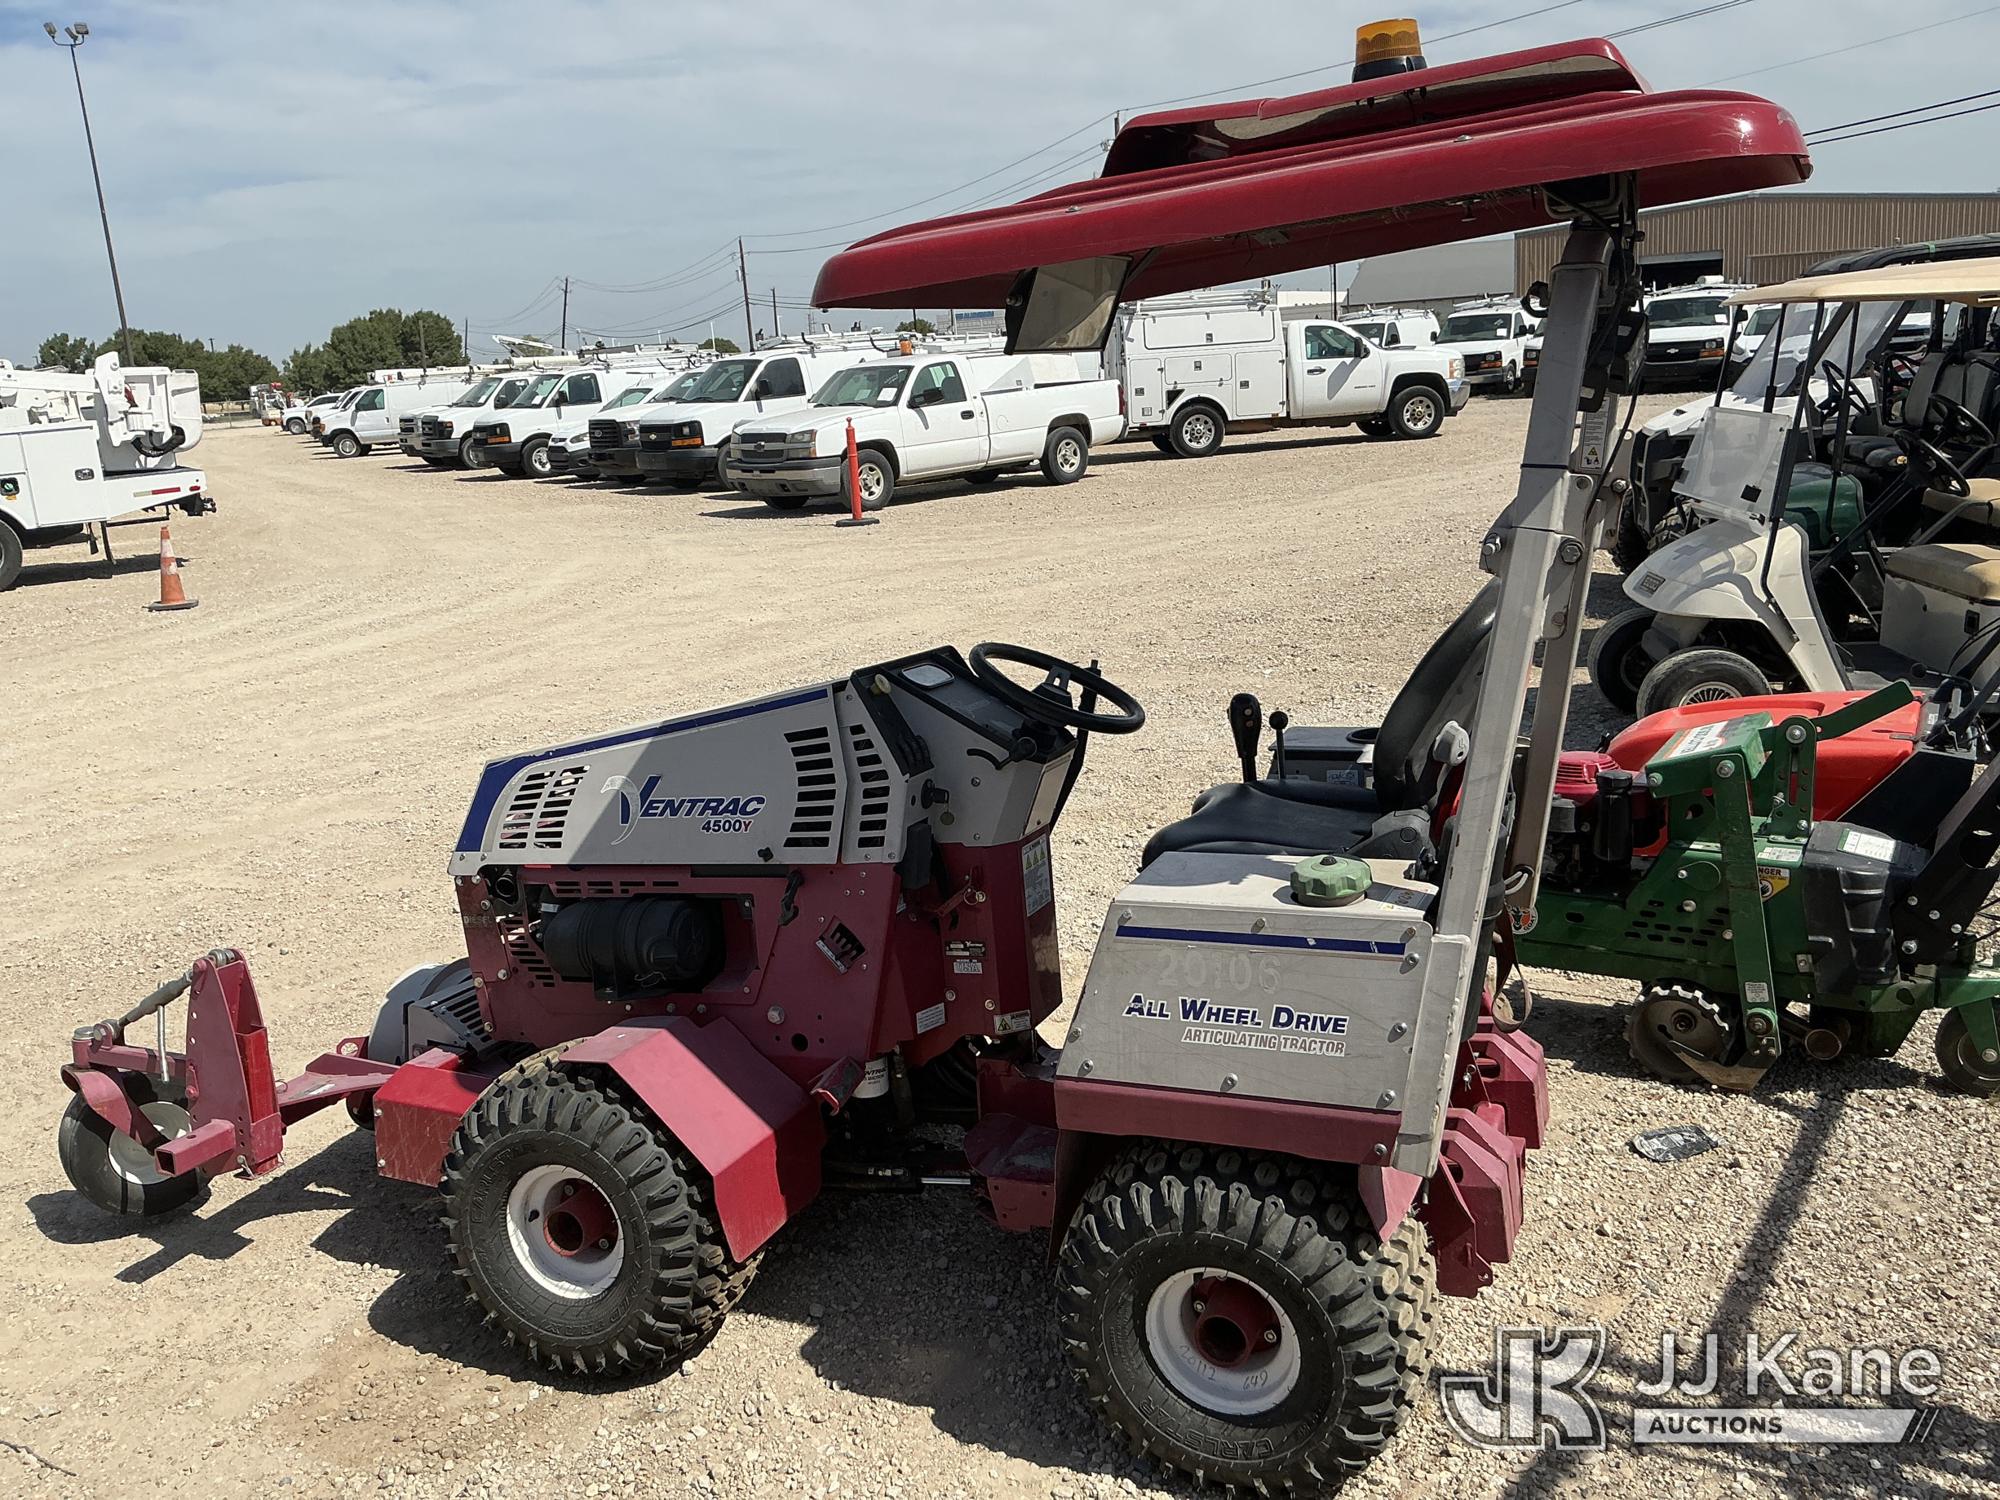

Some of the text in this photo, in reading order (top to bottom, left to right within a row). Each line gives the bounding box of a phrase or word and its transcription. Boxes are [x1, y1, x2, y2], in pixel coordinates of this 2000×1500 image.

[618, 774, 766, 826] VENTRAC
[701, 819, 752, 833] 4500Y
[1758, 867, 1782, 877] NGER
[1122, 993, 1349, 1034] ALL WHEEL DRIVE
[1181, 1028, 1346, 1057] ARTICULATING TRACTOR
